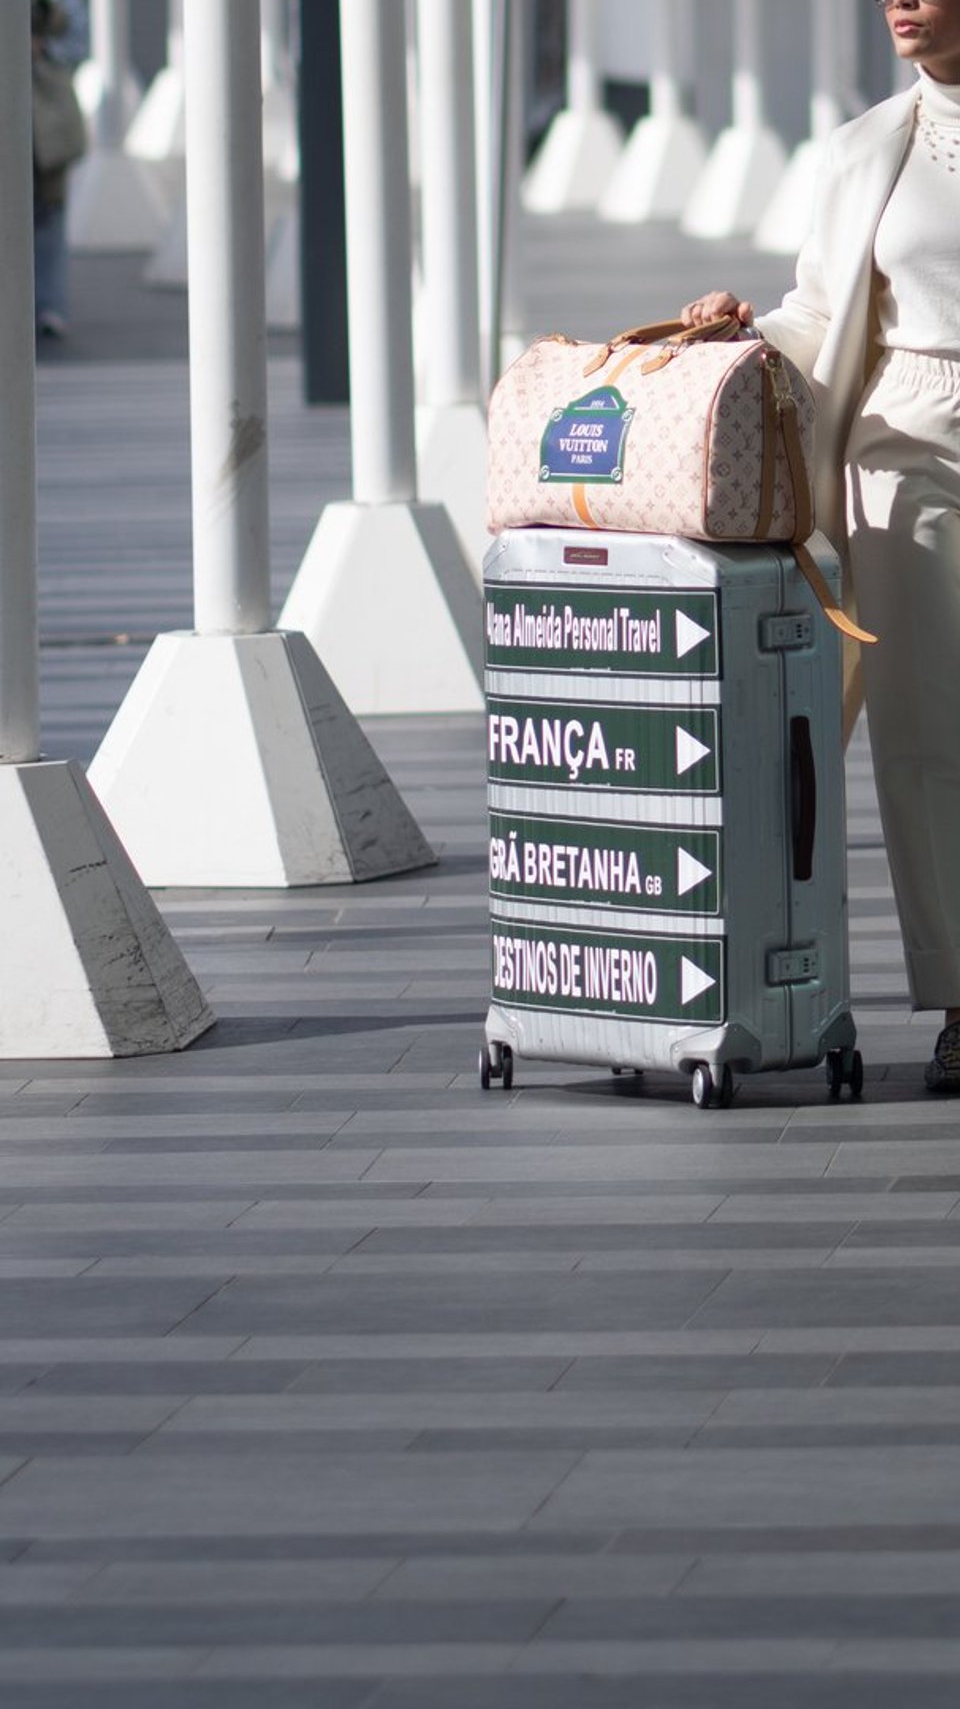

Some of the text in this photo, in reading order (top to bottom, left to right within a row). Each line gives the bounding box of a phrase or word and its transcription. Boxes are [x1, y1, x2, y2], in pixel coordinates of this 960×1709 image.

[559, 438, 608, 453] VUITTON
[569, 424, 604, 437] LOUIS
[571, 454, 592, 464] PARIS
[513, 603, 562, 649] Almeida
[564, 605, 618, 651] Personal
[619, 607, 661, 653] Travel
[489, 714, 635, 780] FRANÇA FR
[524, 842, 641, 894] BRETANHA
[645, 875, 662, 896] GB
[560, 943, 581, 997] DE
[584, 946, 657, 1005] INVERNO
